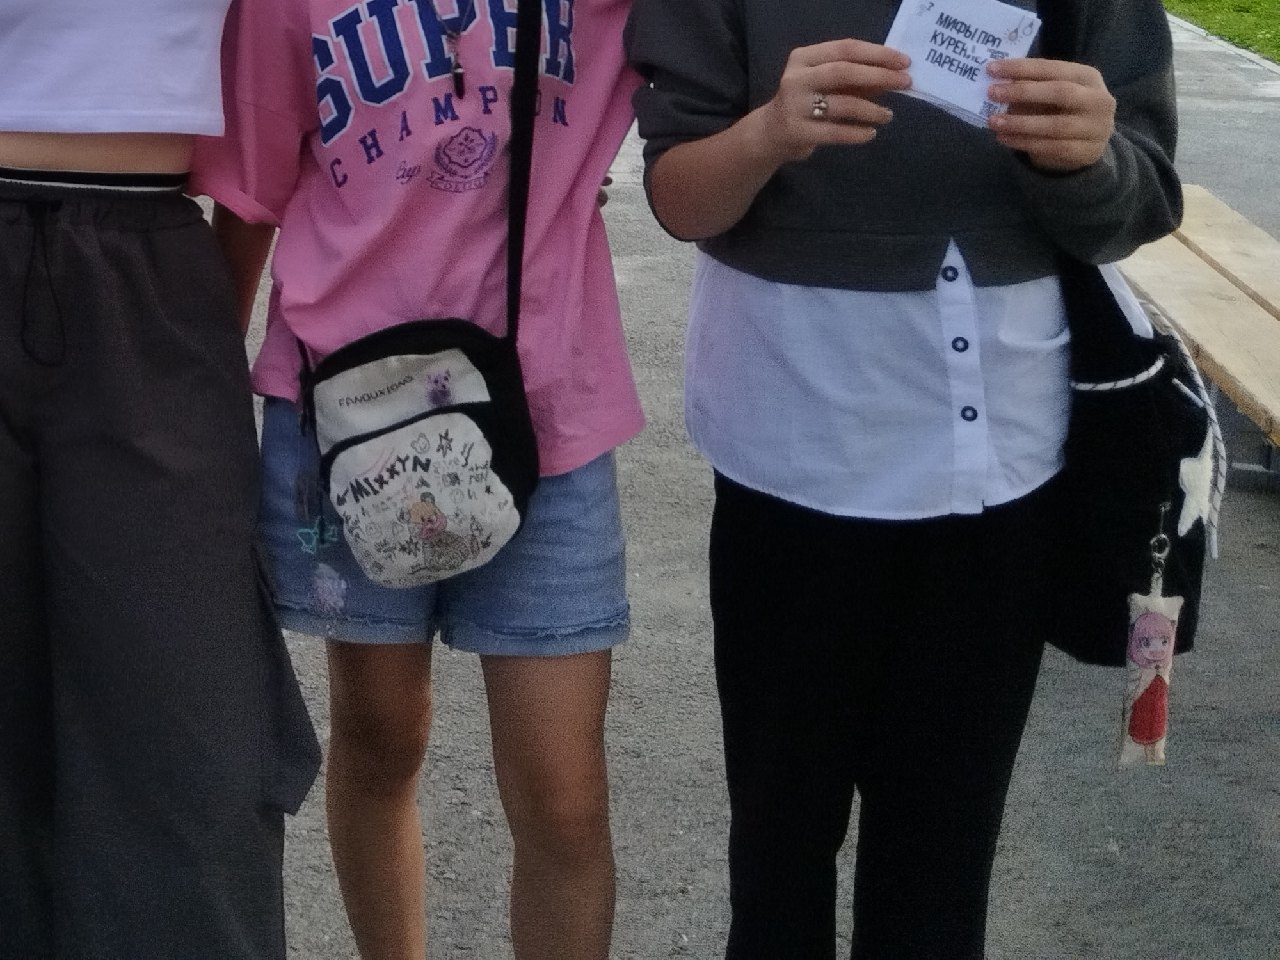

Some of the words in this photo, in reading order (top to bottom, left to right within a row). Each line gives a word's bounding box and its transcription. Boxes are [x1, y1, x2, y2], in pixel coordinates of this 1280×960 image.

[935, 12, 979, 41] МИФЫ
[925, 48, 981, 82] ПАРЕНИЕ
[329, 85, 569, 189] CHAMPN
